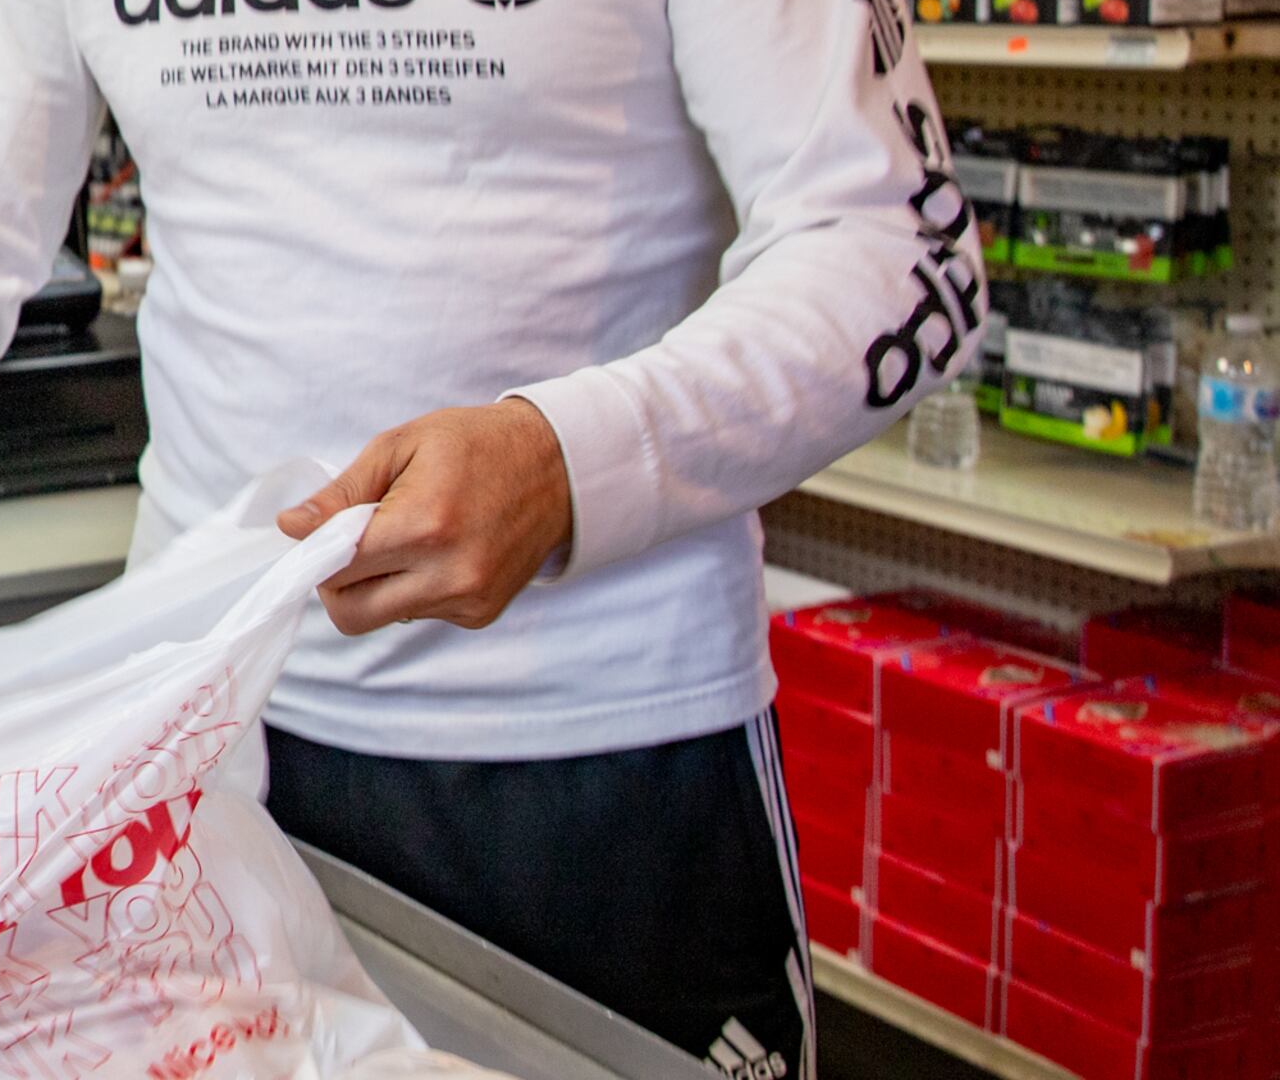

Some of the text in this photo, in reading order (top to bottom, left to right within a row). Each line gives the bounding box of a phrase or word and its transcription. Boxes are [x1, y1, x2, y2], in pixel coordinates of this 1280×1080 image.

[181, 29, 476, 57] THE BRAND WITH THE 3 STRIPES
[160, 57, 506, 87] DIE WELTMARKE MIT DEN 3 STREIFEN
[206, 85, 452, 110] LA MARQUE AUX 3 BANDES
